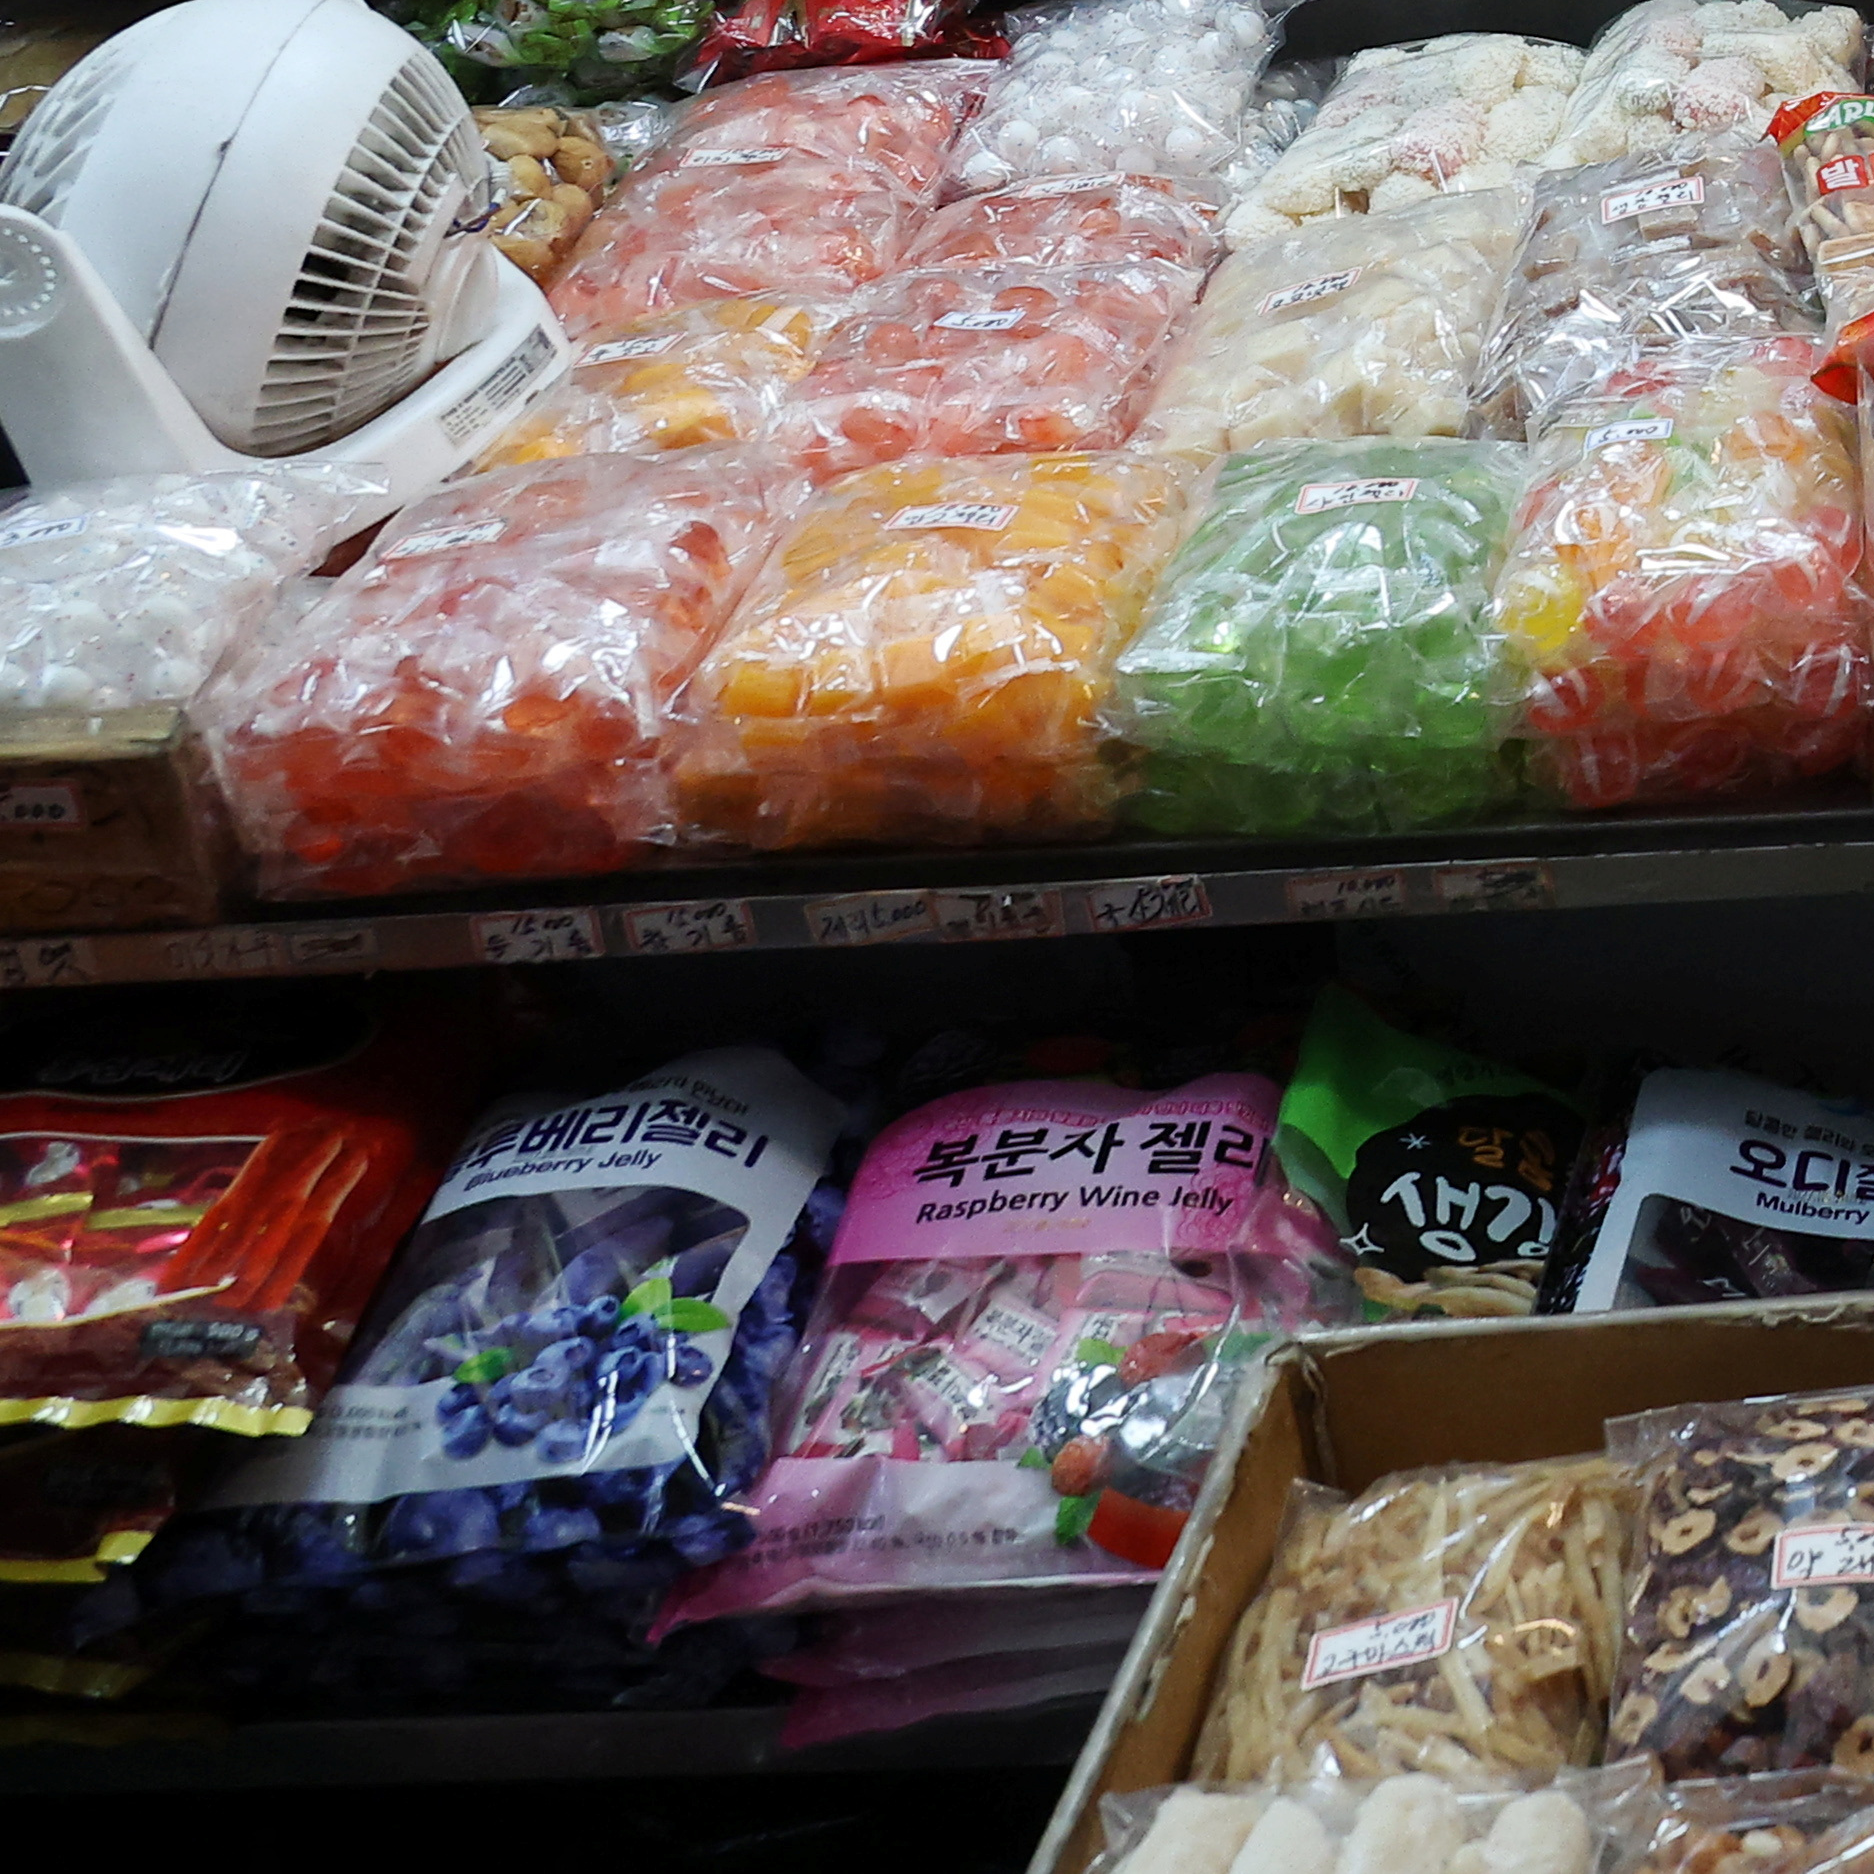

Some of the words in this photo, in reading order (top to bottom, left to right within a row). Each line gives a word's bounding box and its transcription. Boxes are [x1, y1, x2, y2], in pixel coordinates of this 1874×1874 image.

[598, 1148, 664, 1173] Jelly
[915, 1121, 1124, 1185] 복분자
[915, 1185, 1072, 1225] Raspberry
[1080, 1184, 1159, 1209] Wine
[1170, 1184, 1235, 1218] Jelly
[1755, 1191, 1871, 1225] Mulberry
